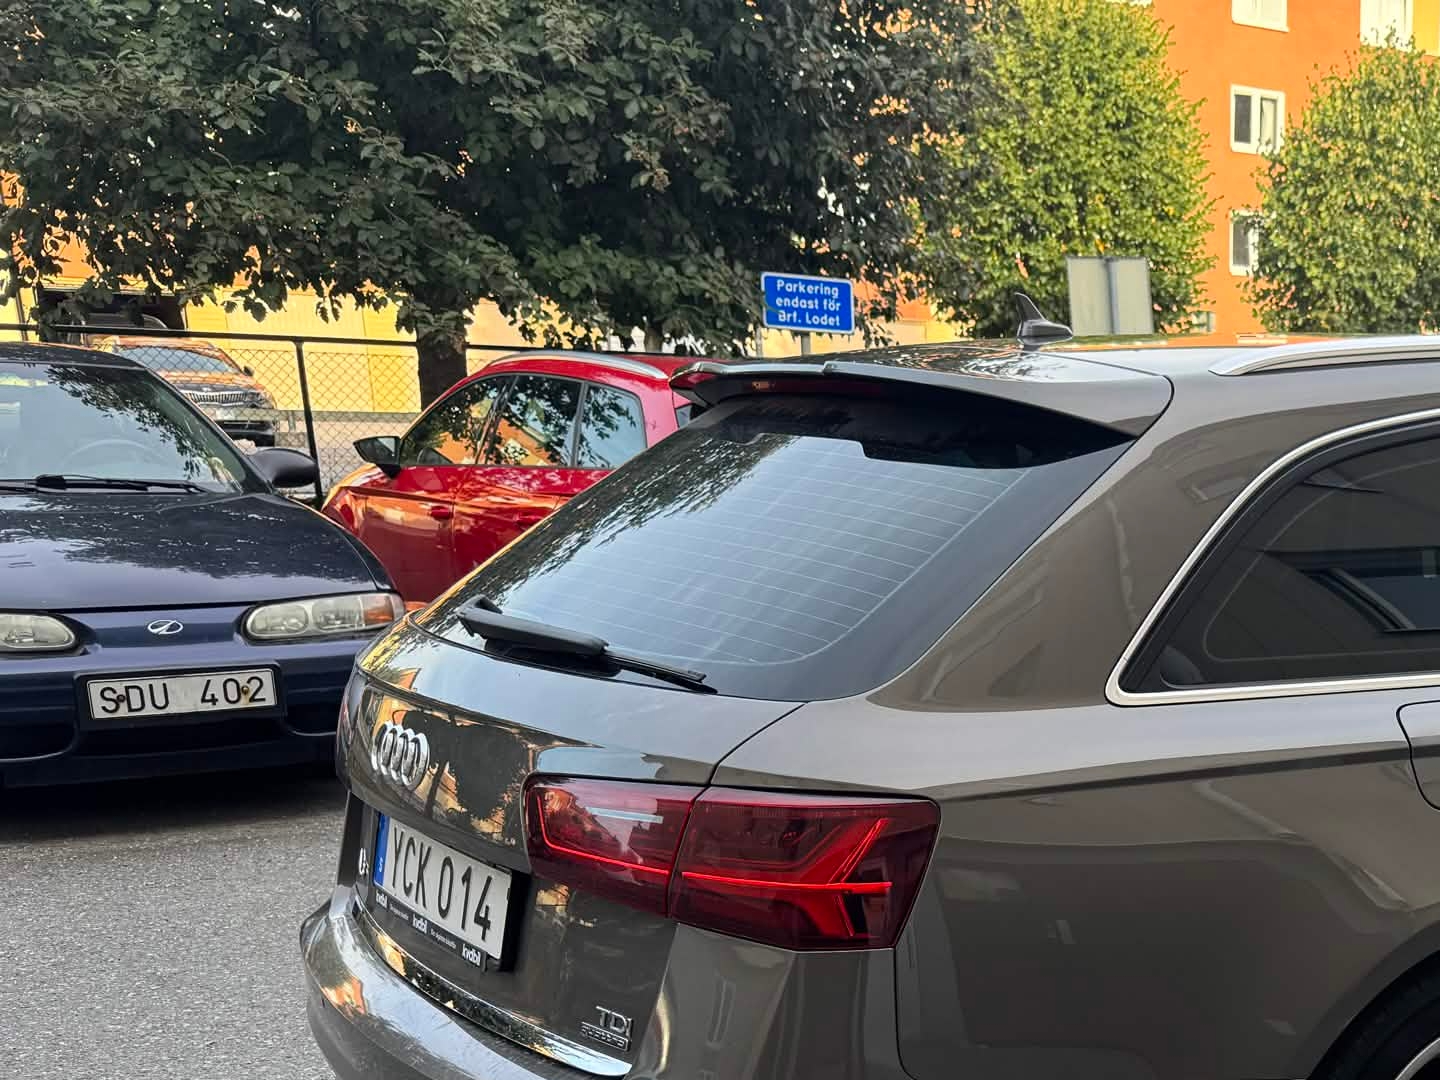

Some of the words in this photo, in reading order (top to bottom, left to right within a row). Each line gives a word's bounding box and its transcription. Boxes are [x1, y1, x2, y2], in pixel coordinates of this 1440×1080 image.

[776, 279, 839, 298] Parkering
[776, 296, 819, 310] endast
[823, 298, 841, 311] för
[805, 311, 840, 326] Lodet
[99, 682, 170, 714] SDU
[200, 676, 266, 706] 402
[392, 826, 432, 909] YCK
[437, 855, 493, 941] 014
[595, 1005, 632, 1037] TDI
